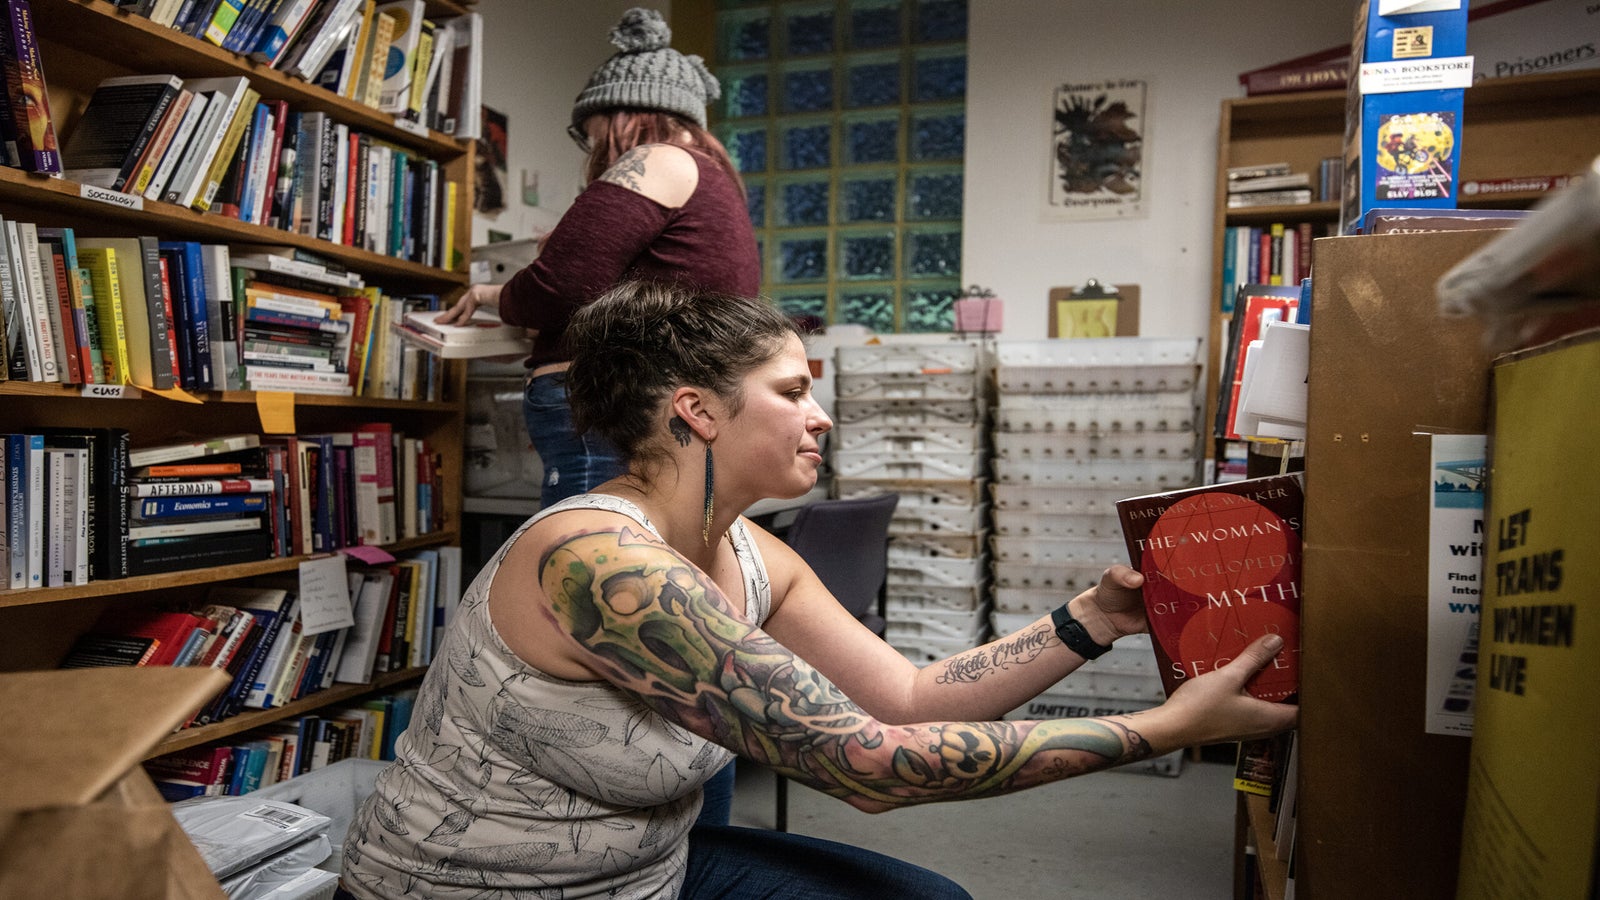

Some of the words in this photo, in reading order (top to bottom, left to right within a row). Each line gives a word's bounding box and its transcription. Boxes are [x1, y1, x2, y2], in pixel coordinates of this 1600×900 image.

[16, 7, 27, 50] HACIENDO
[1363, 68, 1397, 76] KINKY
[1402, 62, 1471, 73] BOOKSTORE
[1495, 43, 1596, 78] Prisoners
[1281, 69, 1348, 88] DICTIONA
[146, 92, 171, 132] ABANDONED
[320, 117, 331, 164] WARRIOR
[137, 168, 151, 187] USED
[320, 165, 328, 187] COP
[1480, 181, 1550, 193] Dictionary
[87, 189, 136, 207] SOCIOLOGY
[1387, 190, 1409, 198] ELLY
[1414, 189, 1437, 197] BLUE
[0, 262, 10, 278] END
[55, 257, 65, 283] GLOBAL
[109, 261, 117, 280] DON'T
[0, 279, 14, 302] GAME
[59, 286, 69, 308] SLUMP
[111, 282, 120, 300] WANT
[114, 301, 121, 310] TO
[152, 272, 166, 340] EVICTED
[38, 318, 49, 343] FORGOTTEN
[116, 323, 125, 340] POOR
[194, 320, 206, 353] YUNUS
[42, 343, 52, 359] PLACES
[92, 387, 120, 395] CLASS
[11, 466, 19, 498] STATISTICS
[150, 483, 214, 496] AFTERMATH
[120, 486, 129, 525] STRUGGLE
[174, 500, 211, 511] Economics
[1129, 502, 1198, 520] BARBARA
[1222, 488, 1288, 506] WALKER
[11, 504, 19, 551] METHODOLOGY
[88, 514, 94, 522] &
[1136, 535, 1177, 551] THE
[1190, 518, 1300, 544] WOMAN'S
[1499, 508, 1531, 552] LET
[120, 535, 129, 575] EXISTENCE
[1450, 542, 1483, 558] wit
[1144, 552, 1294, 584] ENCYCLOPEDI
[1448, 572, 1477, 582] Find
[1496, 549, 1564, 597] TRANS
[397, 592, 409, 618] Alien
[1154, 601, 1180, 615] OF
[1207, 581, 1299, 610] MYTH
[394, 620, 406, 638] Ink
[1493, 603, 1577, 648] WOMEN
[266, 630, 276, 644] THE
[256, 644, 269, 663] COST
[238, 668, 257, 698] LOYALTY
[1489, 653, 1528, 697] LIVE
[1028, 703, 1090, 718] UNITED
